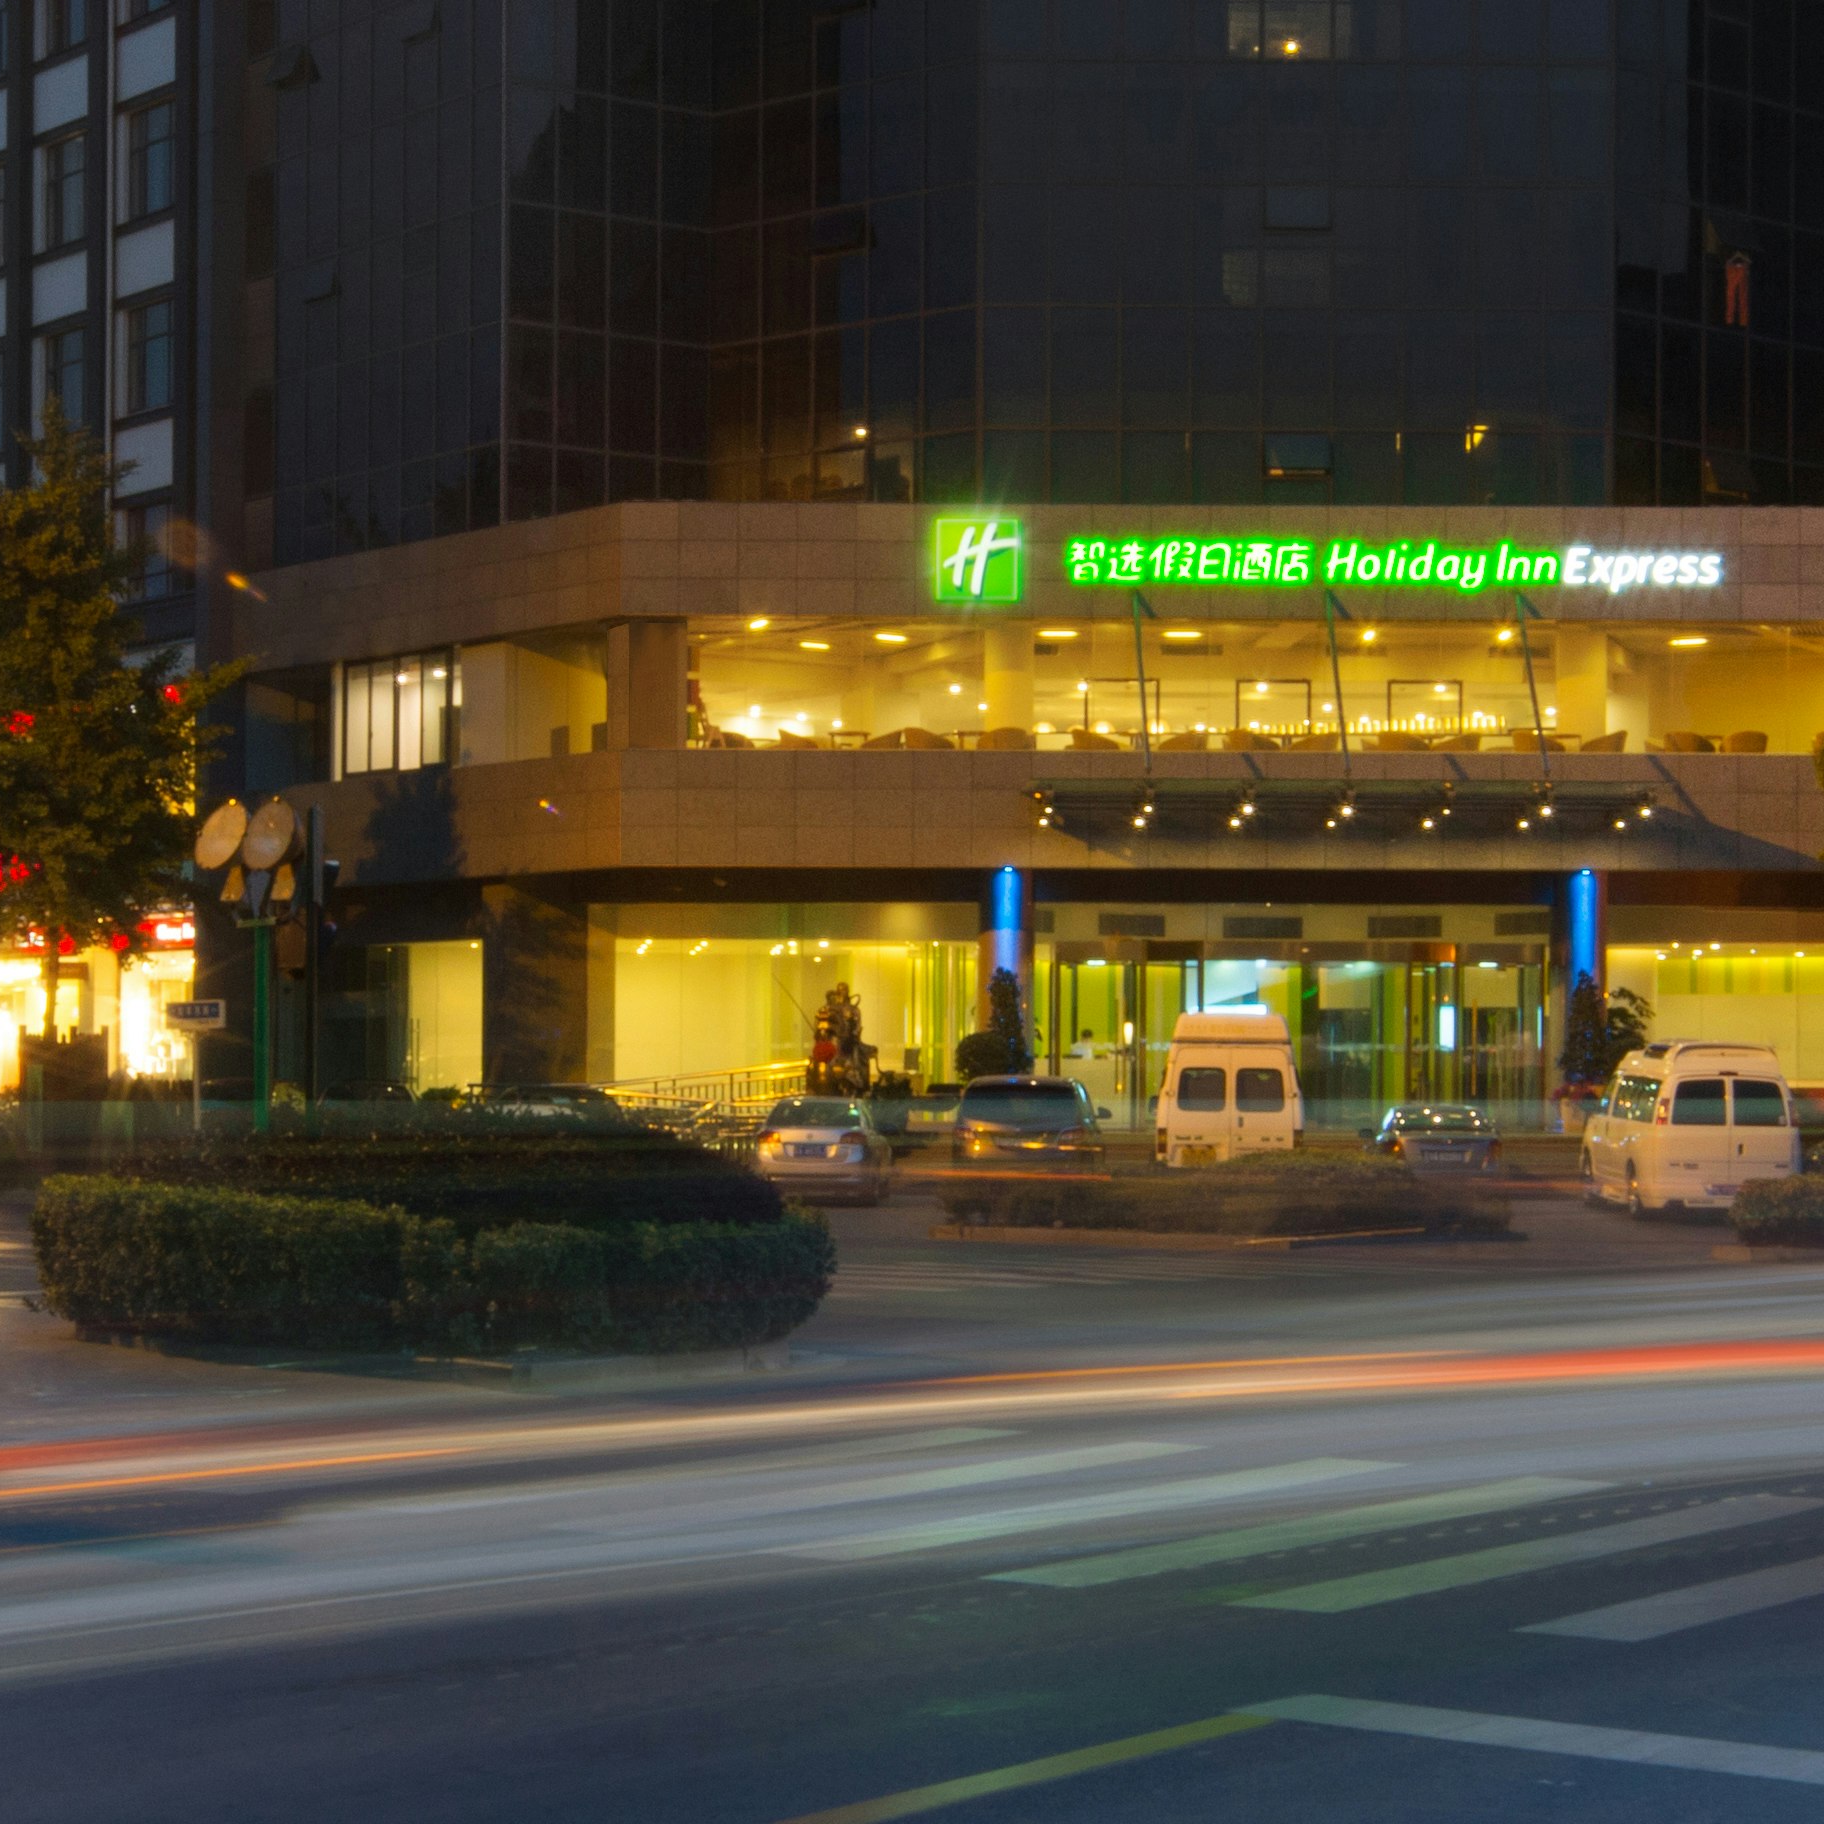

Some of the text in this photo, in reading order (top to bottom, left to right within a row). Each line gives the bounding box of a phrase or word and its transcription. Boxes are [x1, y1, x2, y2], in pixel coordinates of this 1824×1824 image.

[1070, 540, 1310, 582] 智选假日酒店
[1326, 543, 1723, 594] Holiday Inn Express
